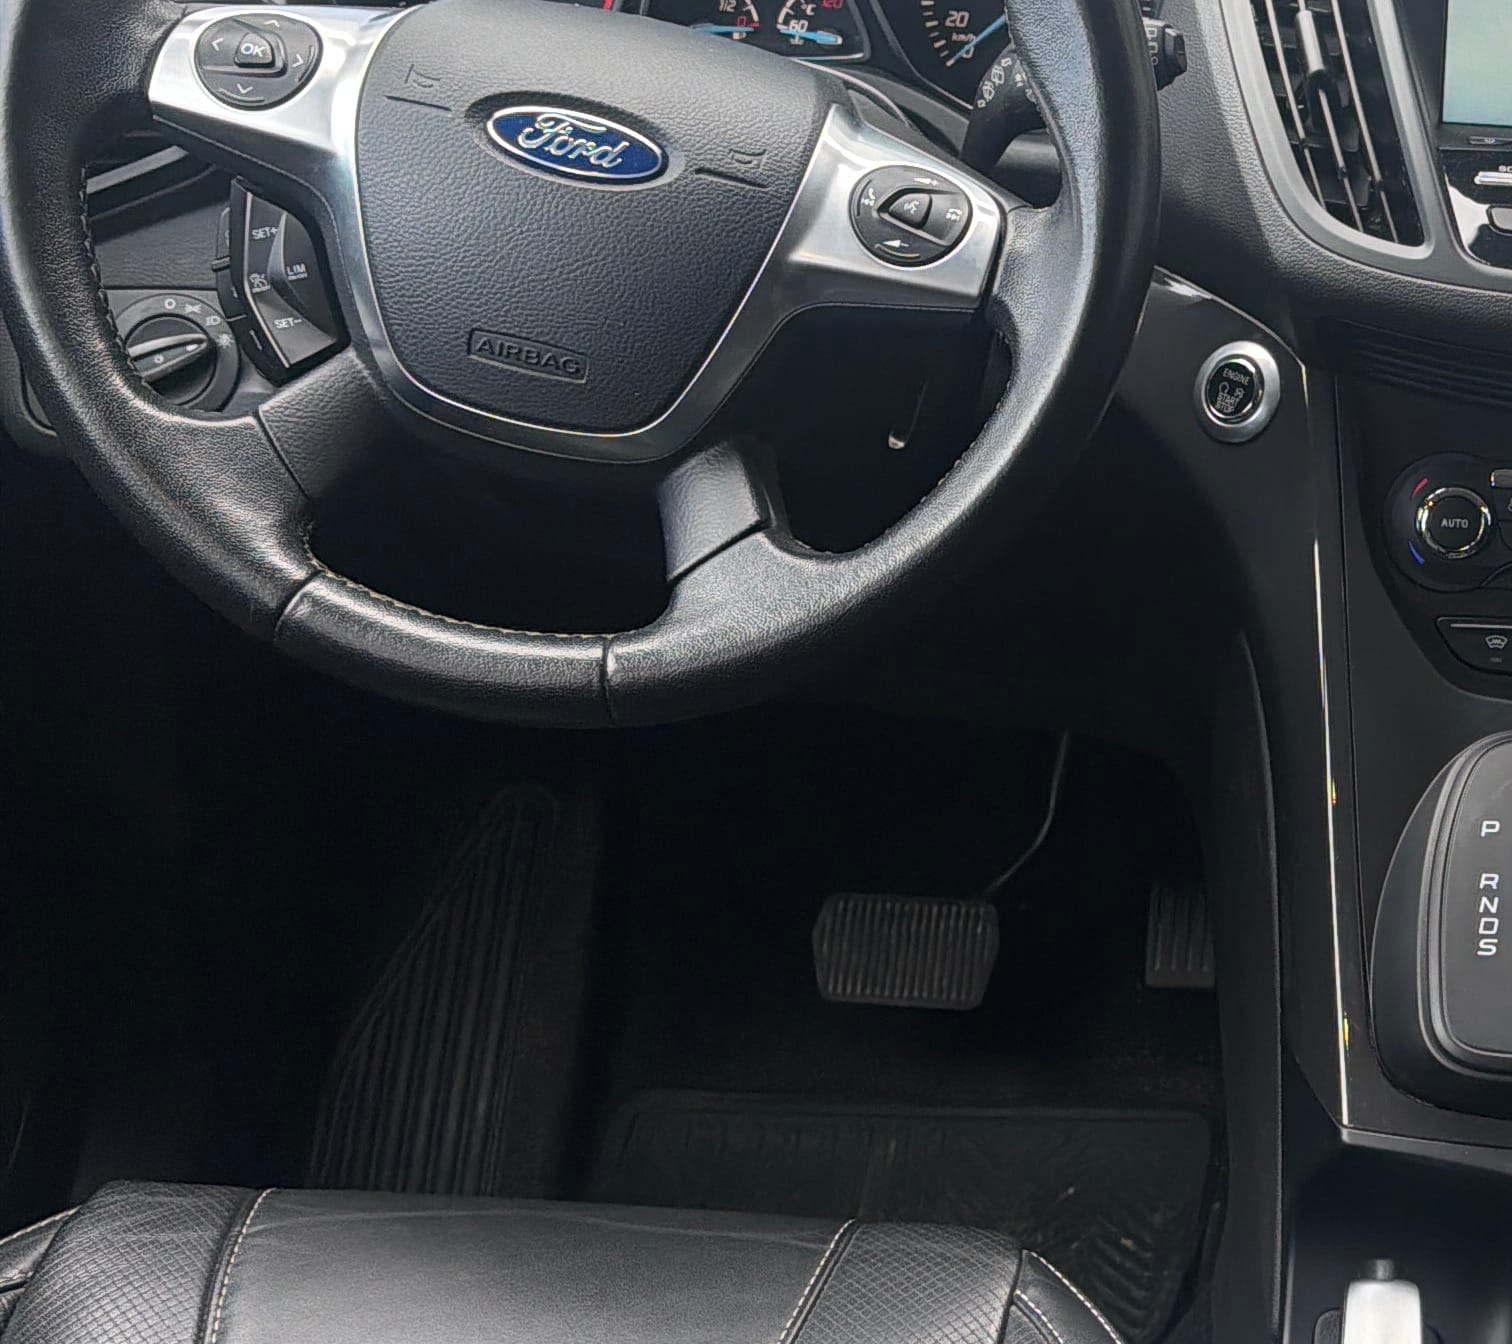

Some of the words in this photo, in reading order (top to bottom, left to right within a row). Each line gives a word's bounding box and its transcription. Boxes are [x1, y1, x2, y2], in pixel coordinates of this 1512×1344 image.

[788, 19, 808, 33] 60
[945, 10, 970, 28] 20
[240, 43, 264, 57] OK
[517, 113, 629, 168] Ford
[475, 337, 582, 375] AIRBAG
[1223, 368, 1250, 386] ENGINE
[1440, 519, 1469, 529] AUTO
[1480, 820, 1501, 837] P
[1479, 873, 1500, 890] R
[1478, 896, 1499, 914] N
[1478, 917, 1499, 935] D
[1476, 938, 1499, 956] S
